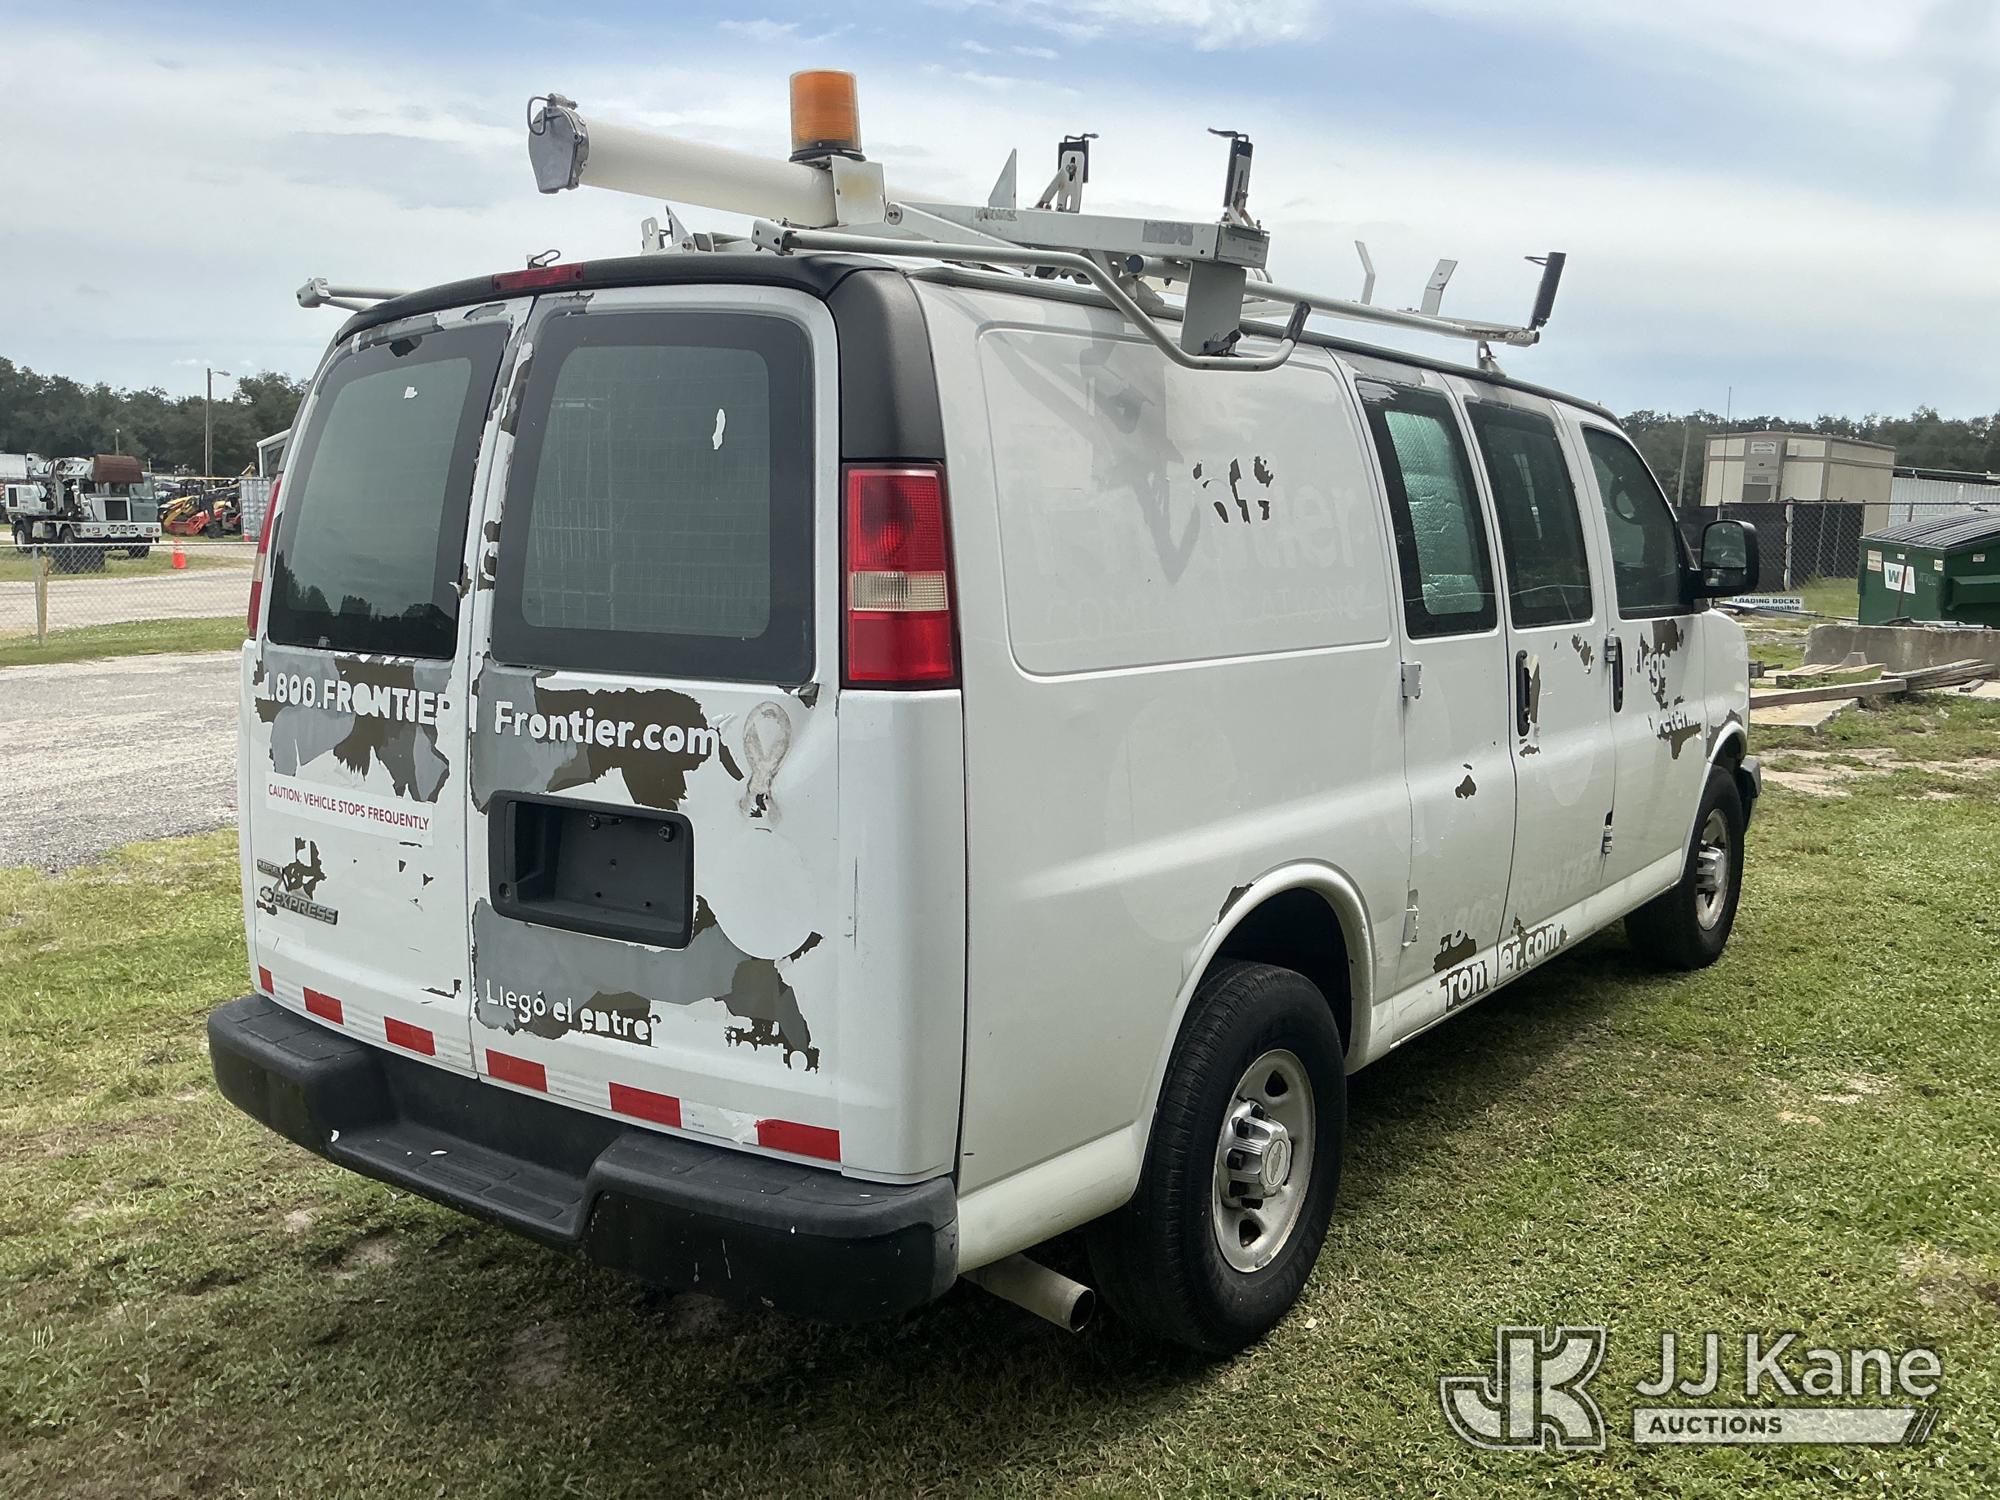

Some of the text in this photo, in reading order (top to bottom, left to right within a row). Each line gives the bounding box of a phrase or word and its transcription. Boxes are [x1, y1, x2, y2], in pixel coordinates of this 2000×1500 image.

[1772, 597, 1801, 605] DOCKS
[494, 701, 719, 755] Frontier.com
[268, 784, 430, 831] CAUTION: VEHICLE STOPS FREQUENTLY
[274, 891, 337, 924] EXPRESS
[486, 979, 546, 1024] Llegó
[552, 997, 573, 1024] el
